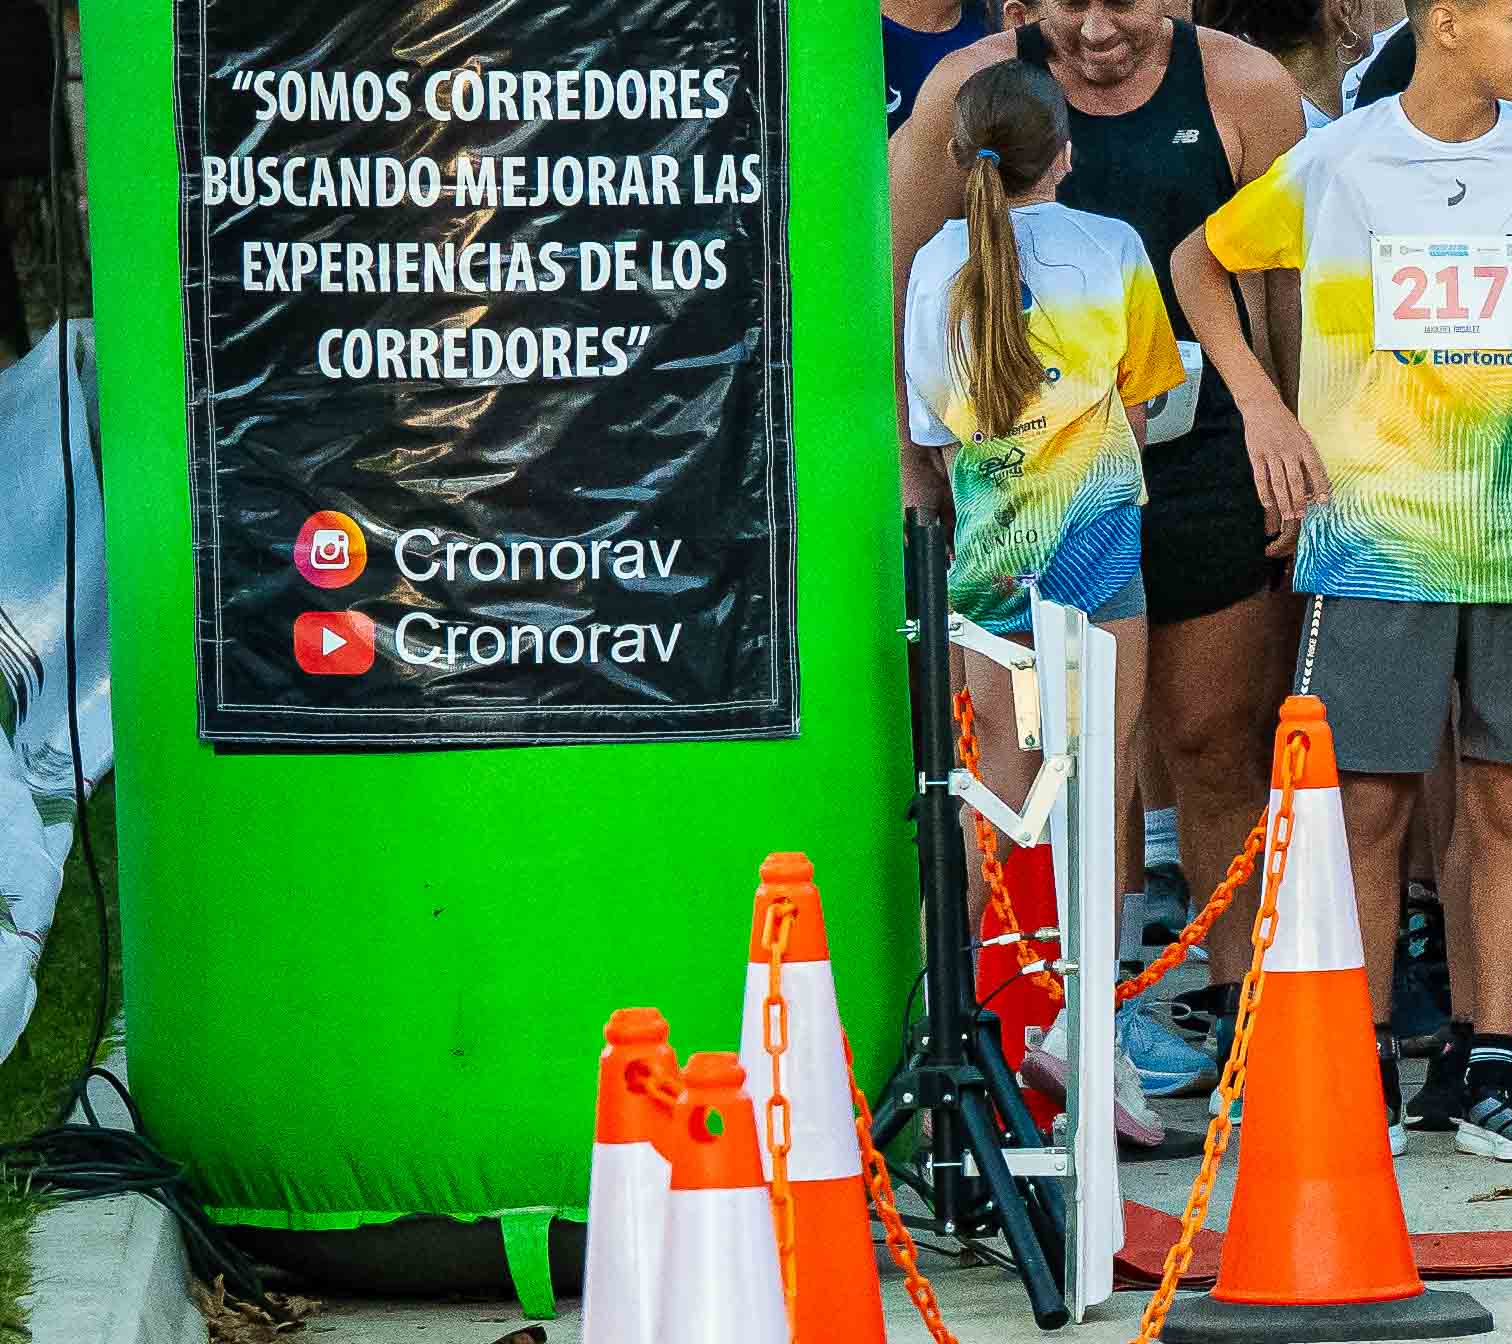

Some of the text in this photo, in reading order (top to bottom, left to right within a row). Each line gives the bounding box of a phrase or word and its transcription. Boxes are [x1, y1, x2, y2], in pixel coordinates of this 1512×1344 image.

[424, 68, 729, 121] CORREDORES
[202, 155, 763, 208] BUSCANDO MEJORAR LAS
[242, 239, 727, 293] EXPERIENCIAS DE LOS
[1391, 265, 1509, 320] 217
[394, 527, 683, 583] Cronorav
[394, 611, 683, 666] Cronorav
